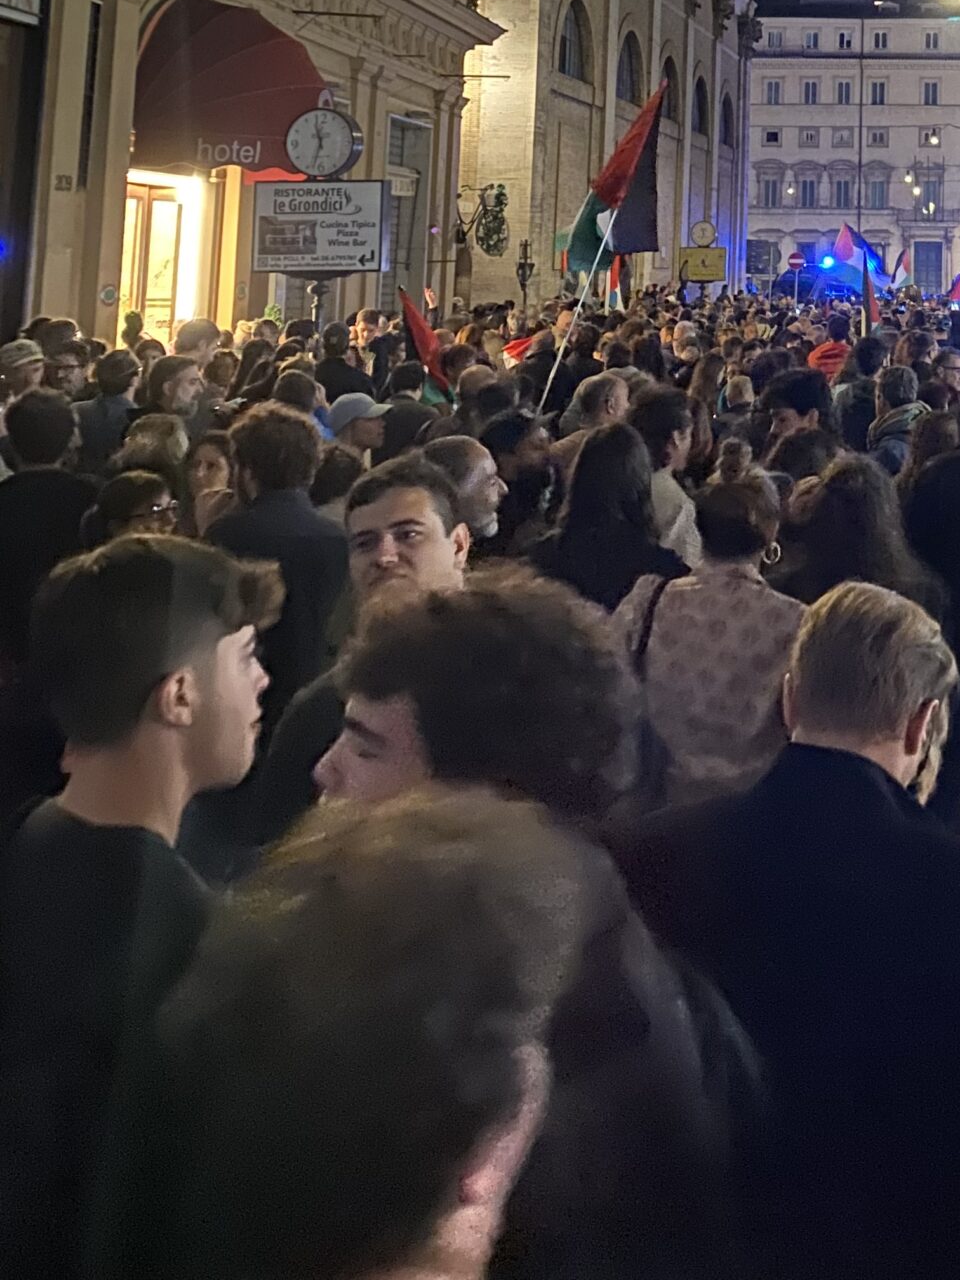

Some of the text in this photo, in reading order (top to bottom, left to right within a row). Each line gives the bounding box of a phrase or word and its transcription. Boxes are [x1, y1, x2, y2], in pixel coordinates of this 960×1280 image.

[196, 138, 261, 164] hotel
[274, 188, 343, 197] RISTORANTE
[289, 197, 343, 212] Grondici
[320, 220, 376, 230] Cucina Tipica
[337, 229, 359, 237] Pizza
[327, 239, 367, 247] Wine Bar
